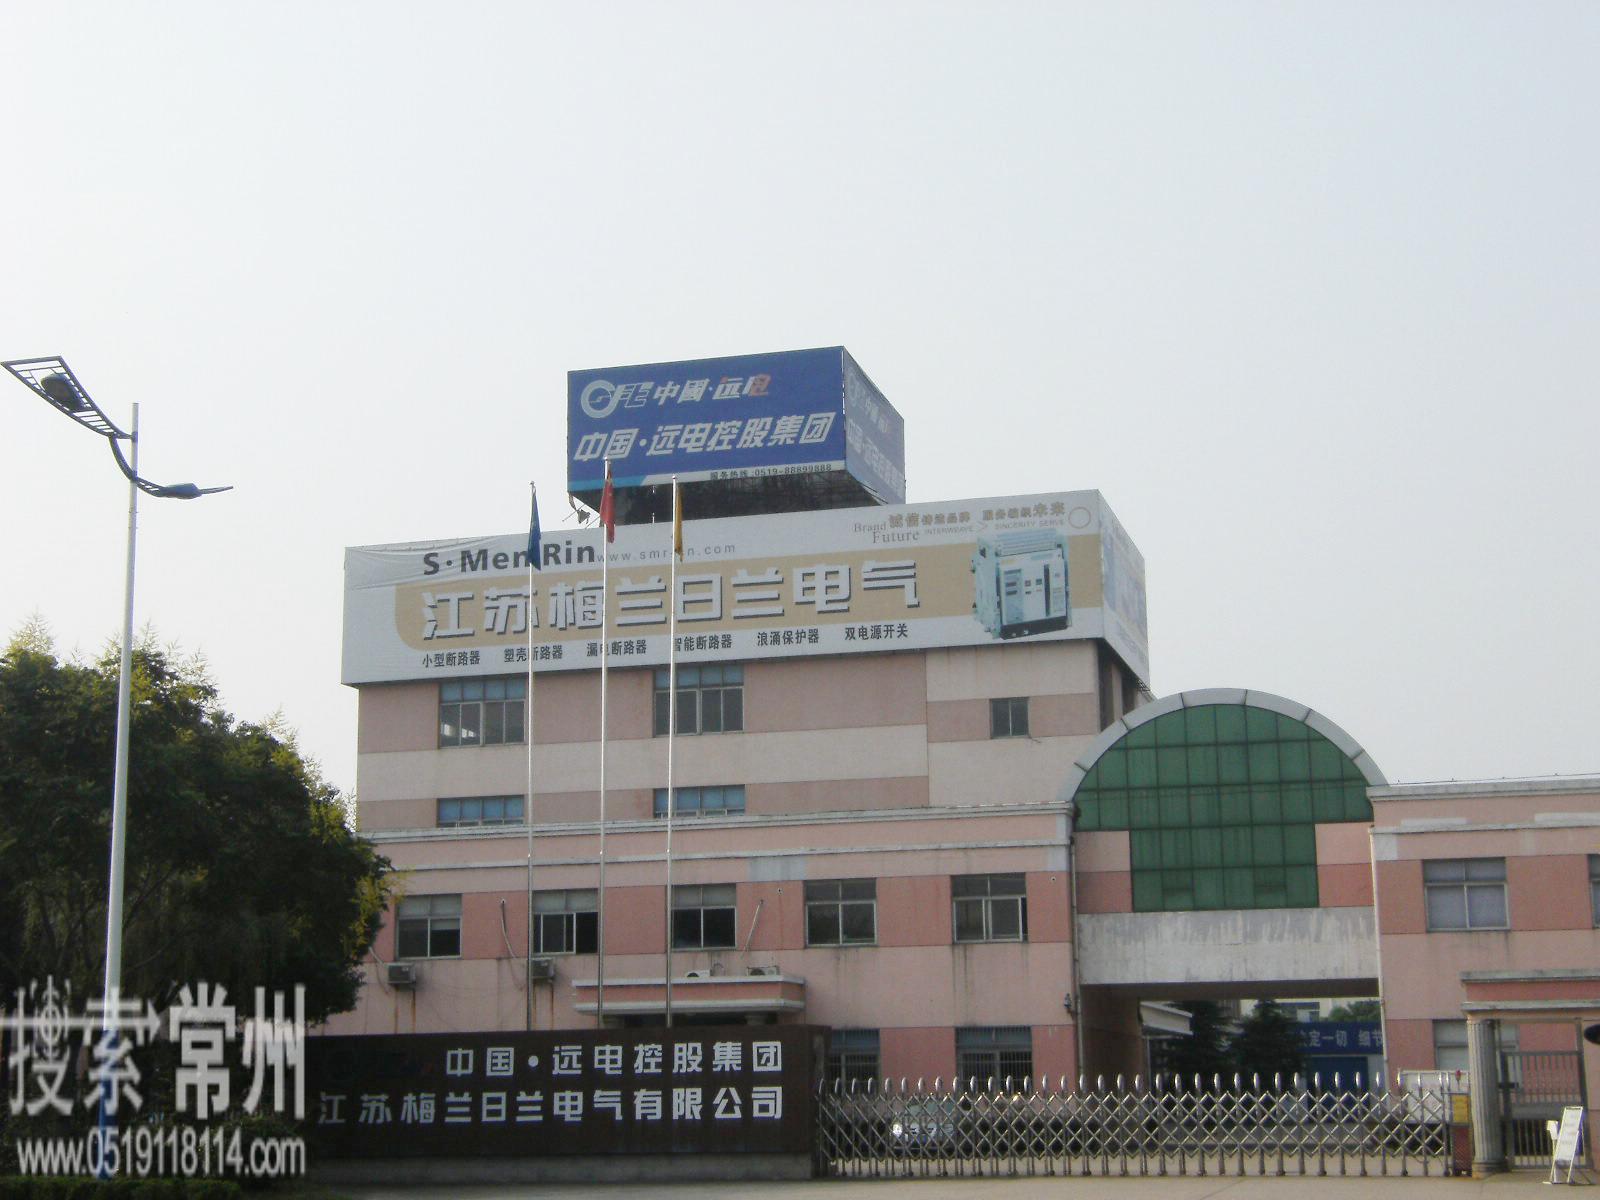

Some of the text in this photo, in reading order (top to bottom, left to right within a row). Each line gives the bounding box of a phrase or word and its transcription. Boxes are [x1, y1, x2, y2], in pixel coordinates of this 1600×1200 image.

[573, 411, 837, 462] 中国·远电控股集团
[854, 521, 887, 532] Brand
[873, 530, 920, 544] Future
[421, 560, 920, 642] 江苏梅兰日兰电气
[422, 650, 481, 668] 小型断路器
[757, 628, 819, 647] 浪涌保护器
[844, 623, 908, 641] 双电源开关
[445, 1040, 783, 1078] 中国·远电控股集团
[318, 1085, 783, 1125] 江苏梅兰日兰电气有限公司
